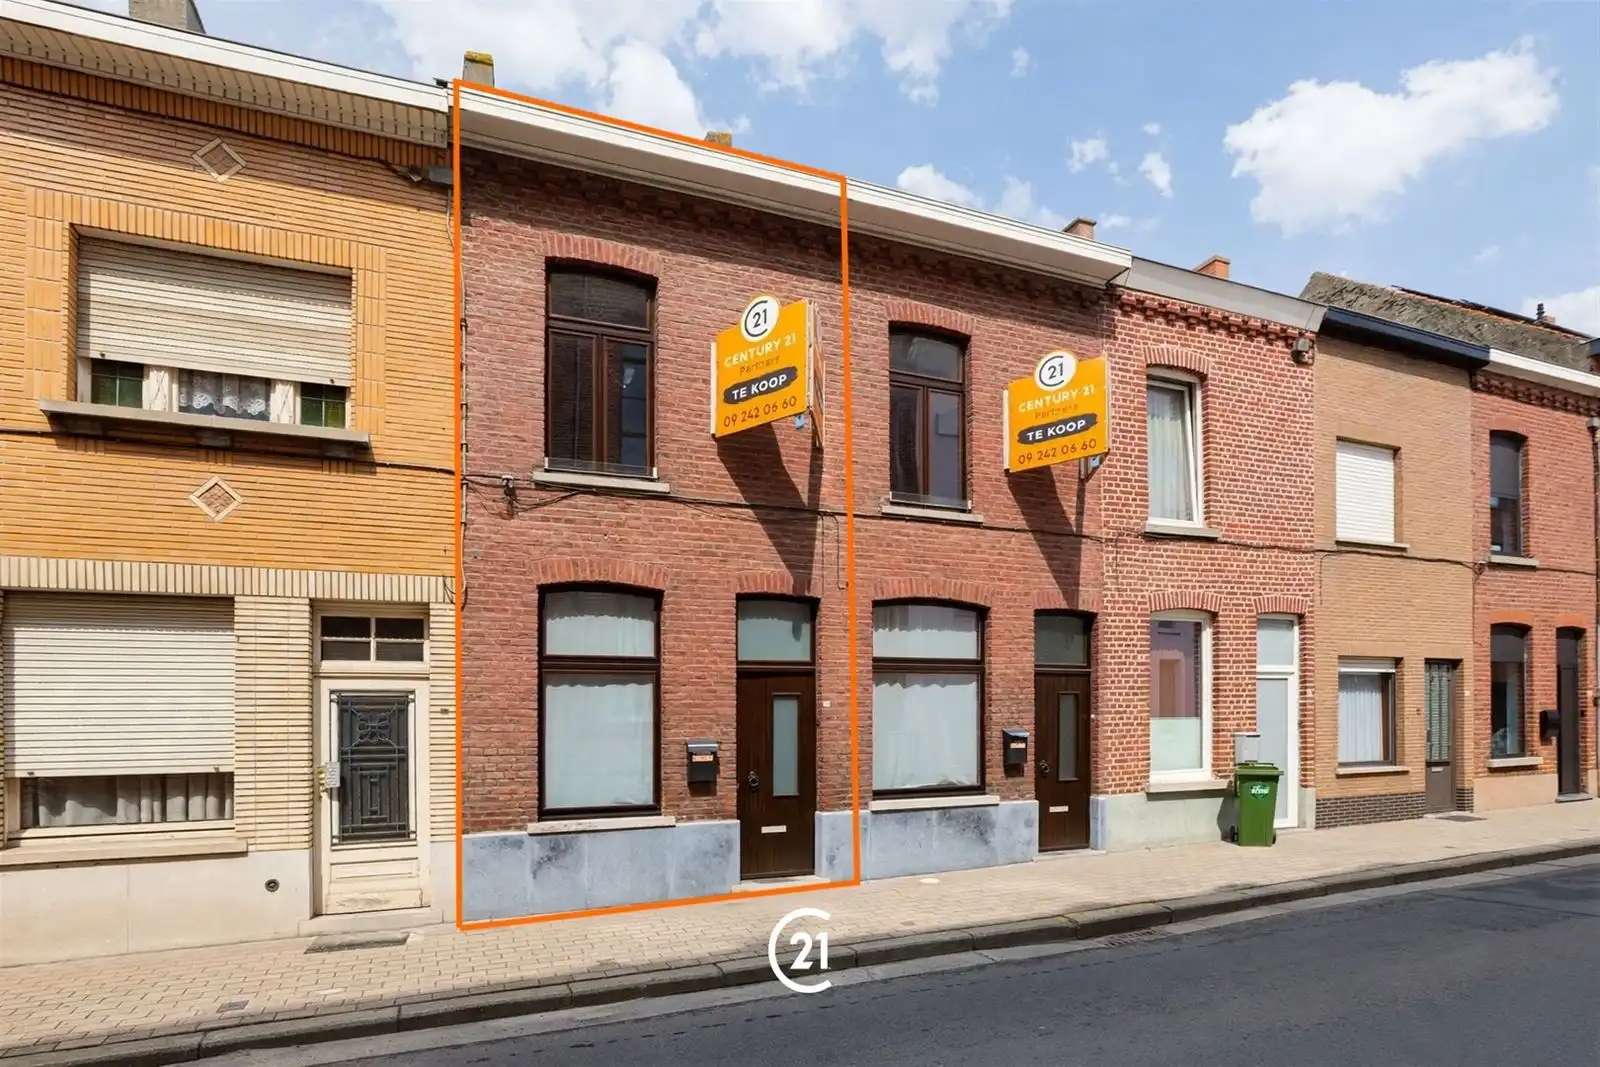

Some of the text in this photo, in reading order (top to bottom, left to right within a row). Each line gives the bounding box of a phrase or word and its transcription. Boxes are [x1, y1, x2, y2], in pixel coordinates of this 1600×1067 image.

[752, 308, 768, 328] 21
[724, 333, 797, 368] CENTURY 21
[1047, 362, 1064, 380] 21
[731, 374, 787, 401] TE KOOP
[1018, 389, 1080, 413] CENTURY
[1082, 384, 1096, 396] 21
[723, 395, 797, 428] 09 242 06 60
[1026, 419, 1087, 441] TE KOOP
[1018, 438, 1097, 465] 09 242 06 60
